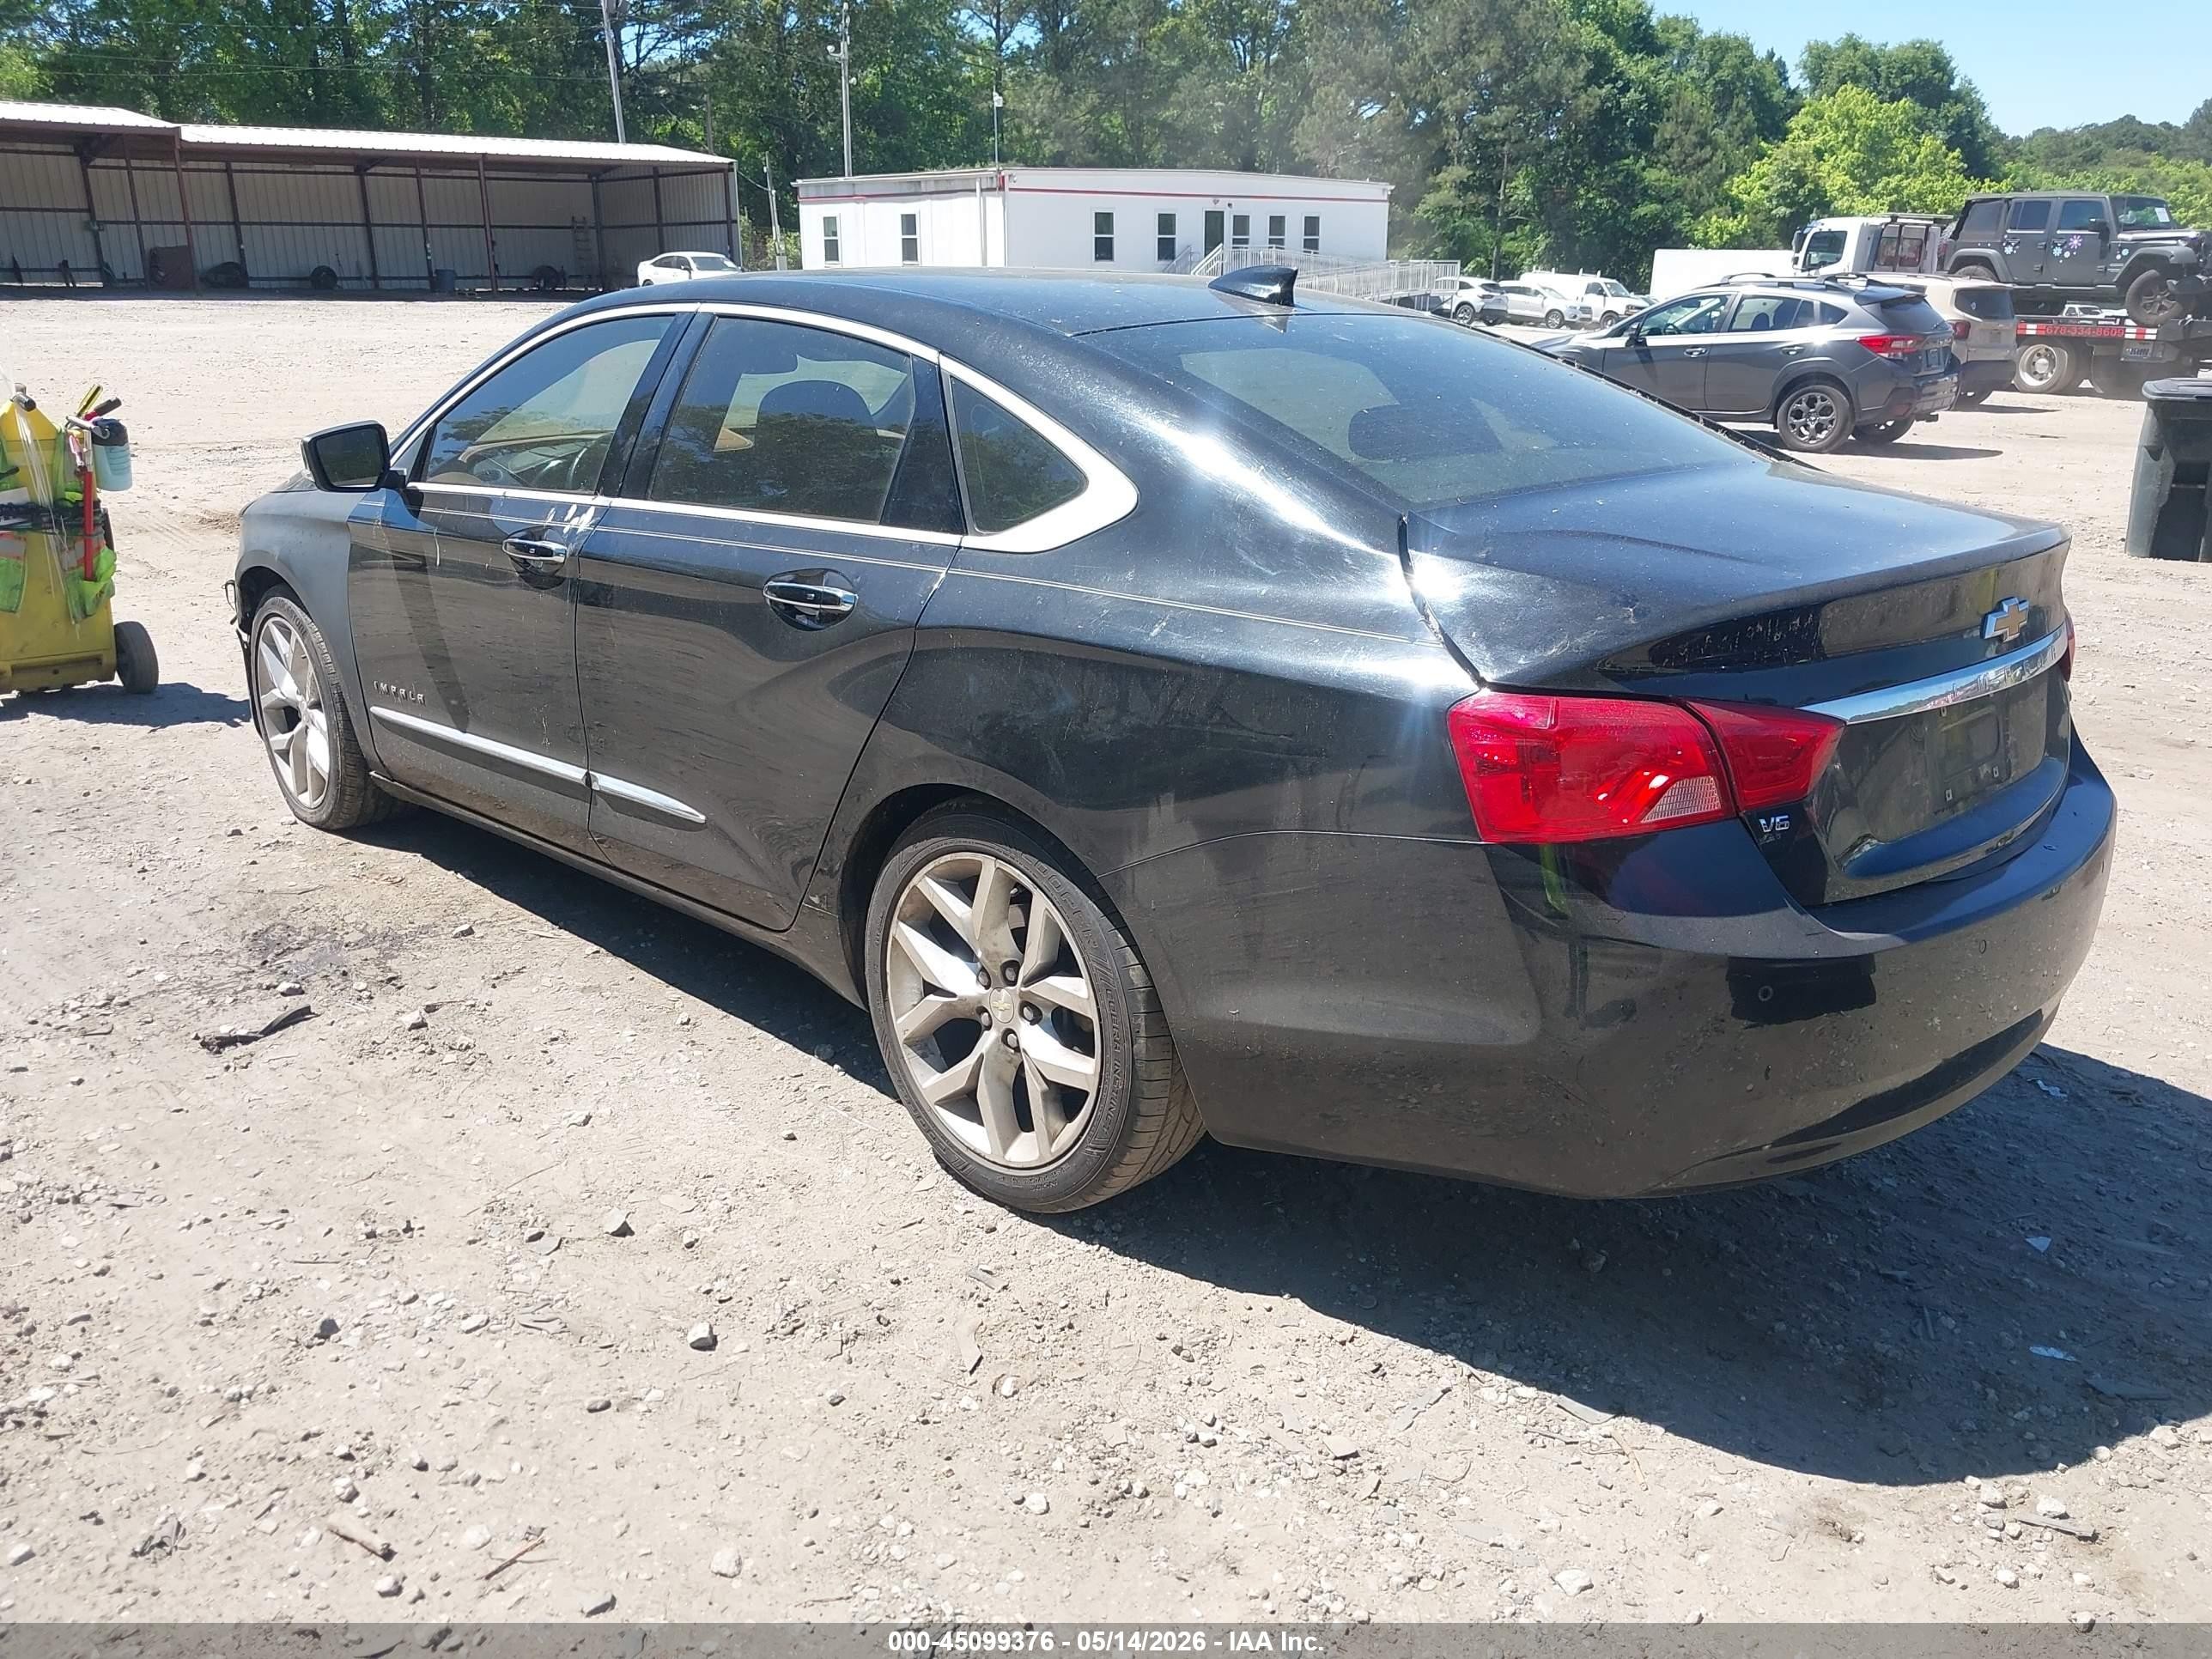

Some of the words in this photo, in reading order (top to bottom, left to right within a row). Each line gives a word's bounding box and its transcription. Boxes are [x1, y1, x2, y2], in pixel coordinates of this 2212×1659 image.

[2046, 325, 2125, 337] 678-334-8609
[374, 680, 425, 705] IMPALA
[1759, 815, 1790, 832] V6
